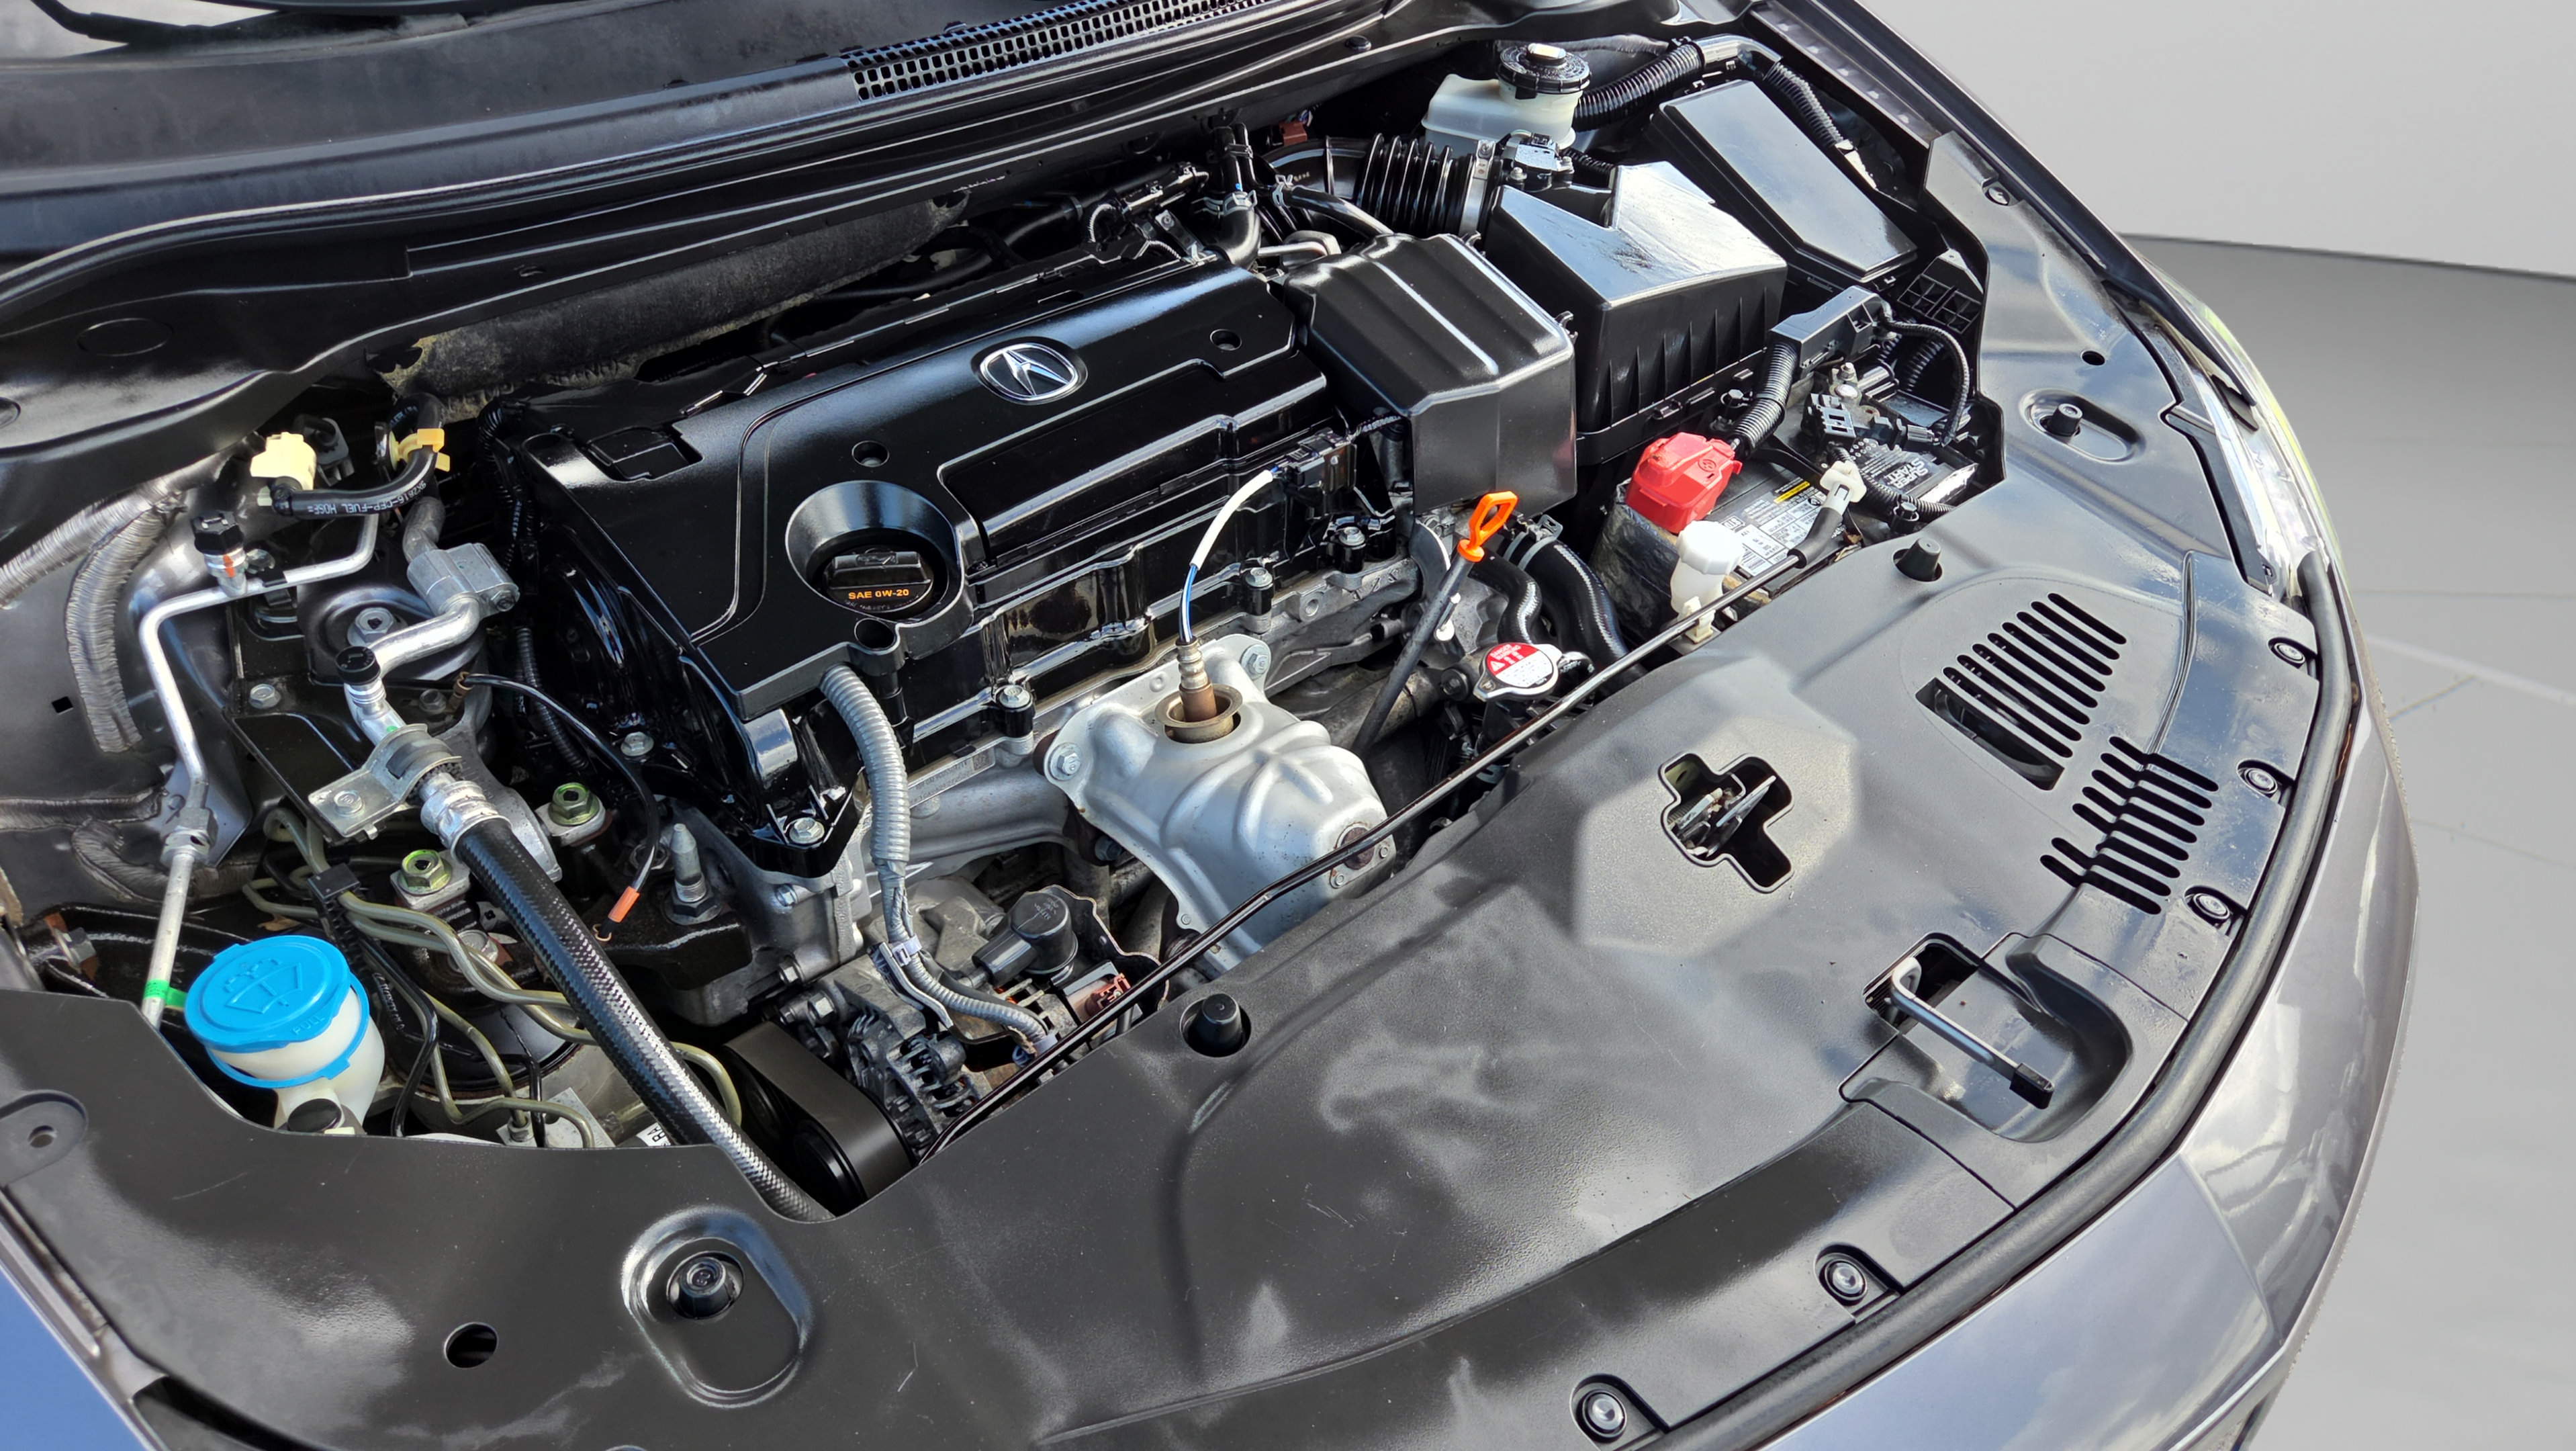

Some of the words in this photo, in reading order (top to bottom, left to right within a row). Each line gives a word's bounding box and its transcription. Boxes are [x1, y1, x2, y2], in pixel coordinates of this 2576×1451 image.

[1886, 457, 1926, 485] START
[1894, 468, 1929, 489] SUPER
[848, 591, 872, 600] SAE
[875, 588, 909, 597] 0W-20
[1490, 644, 1512, 658] DANGER
[293, 1015, 325, 1035] PULL
